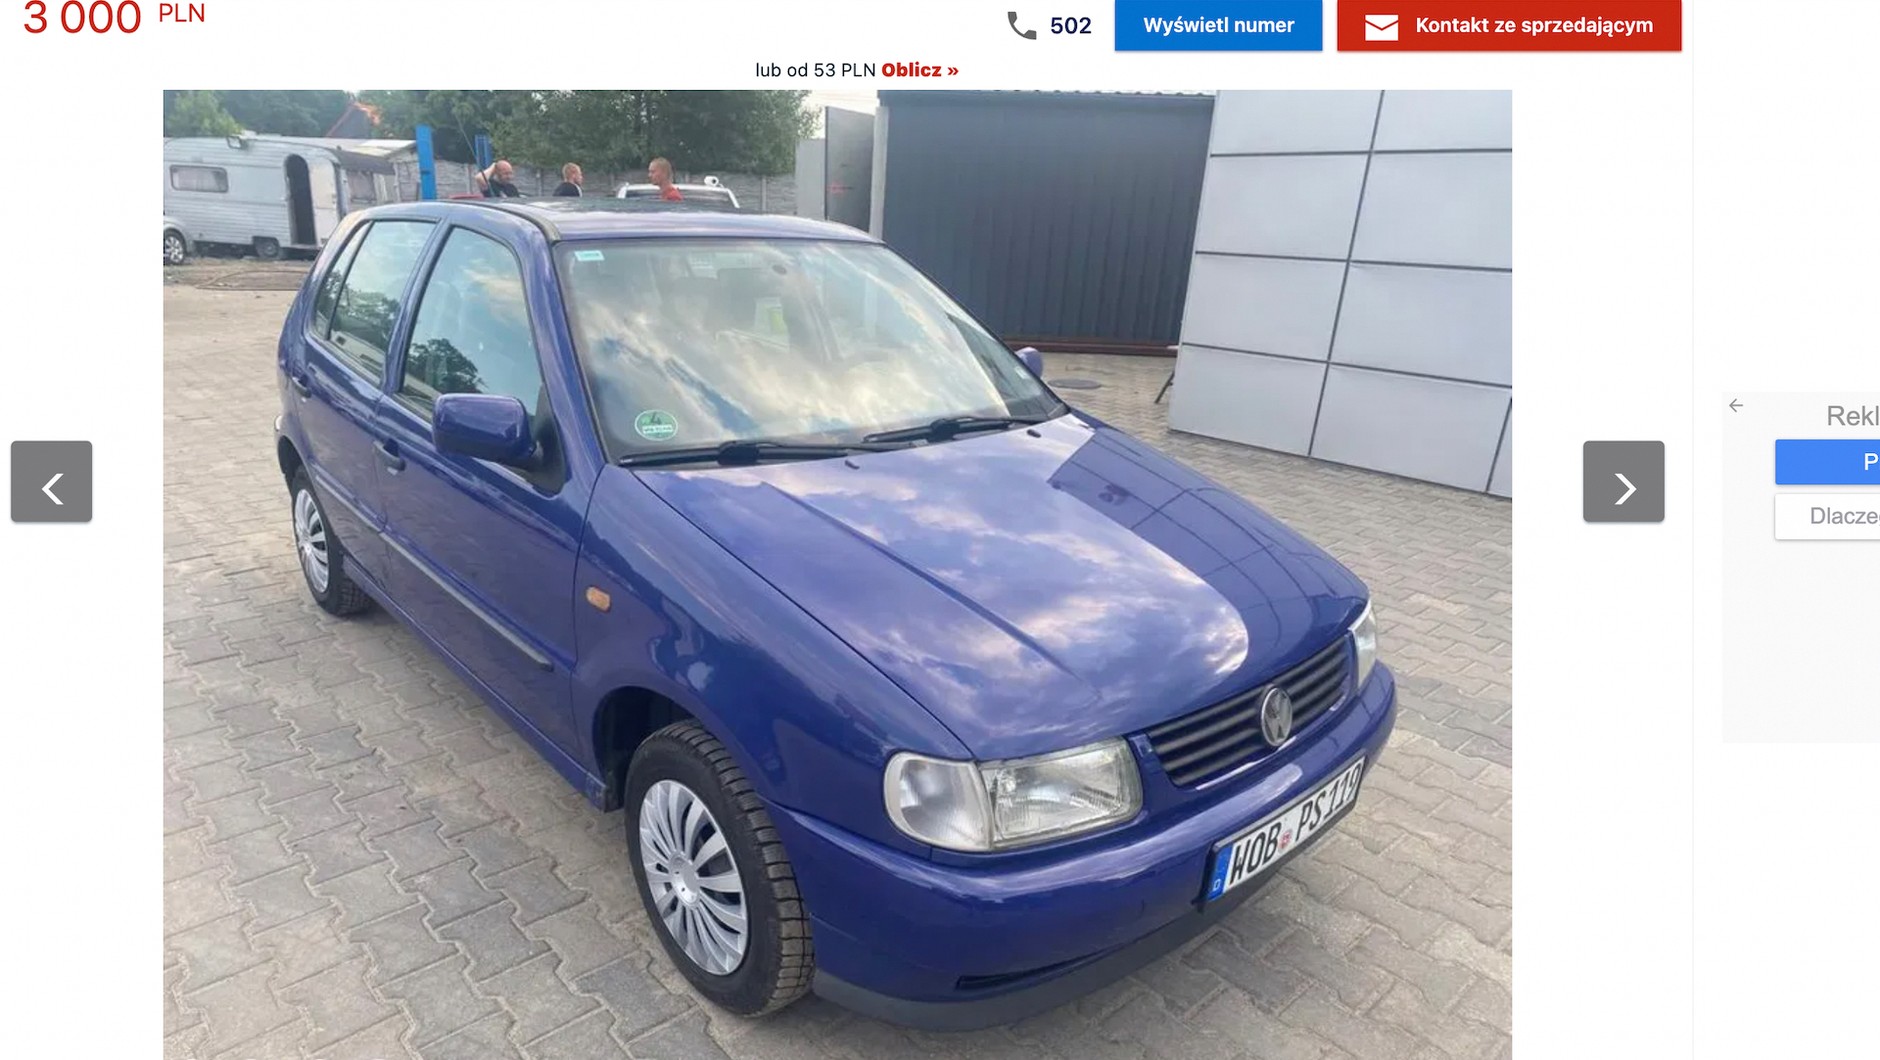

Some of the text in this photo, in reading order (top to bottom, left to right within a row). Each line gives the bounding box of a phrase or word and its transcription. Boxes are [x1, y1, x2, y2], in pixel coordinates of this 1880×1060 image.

[24, 0, 205, 34] 3 000 PLN
[1050, 17, 1092, 35] 502
[1143, 15, 1296, 37] Wyświetl numer
[1416, 15, 1654, 38] Kontakt ze sprzedającym
[755, 62, 782, 78] lub
[787, 62, 808, 78] od
[814, 62, 836, 78] 53
[841, 62, 876, 78] PLN
[881, 61, 943, 78] Oblicz
[1810, 506, 1880, 526] Dlacze
[1230, 821, 1282, 885] WOB
